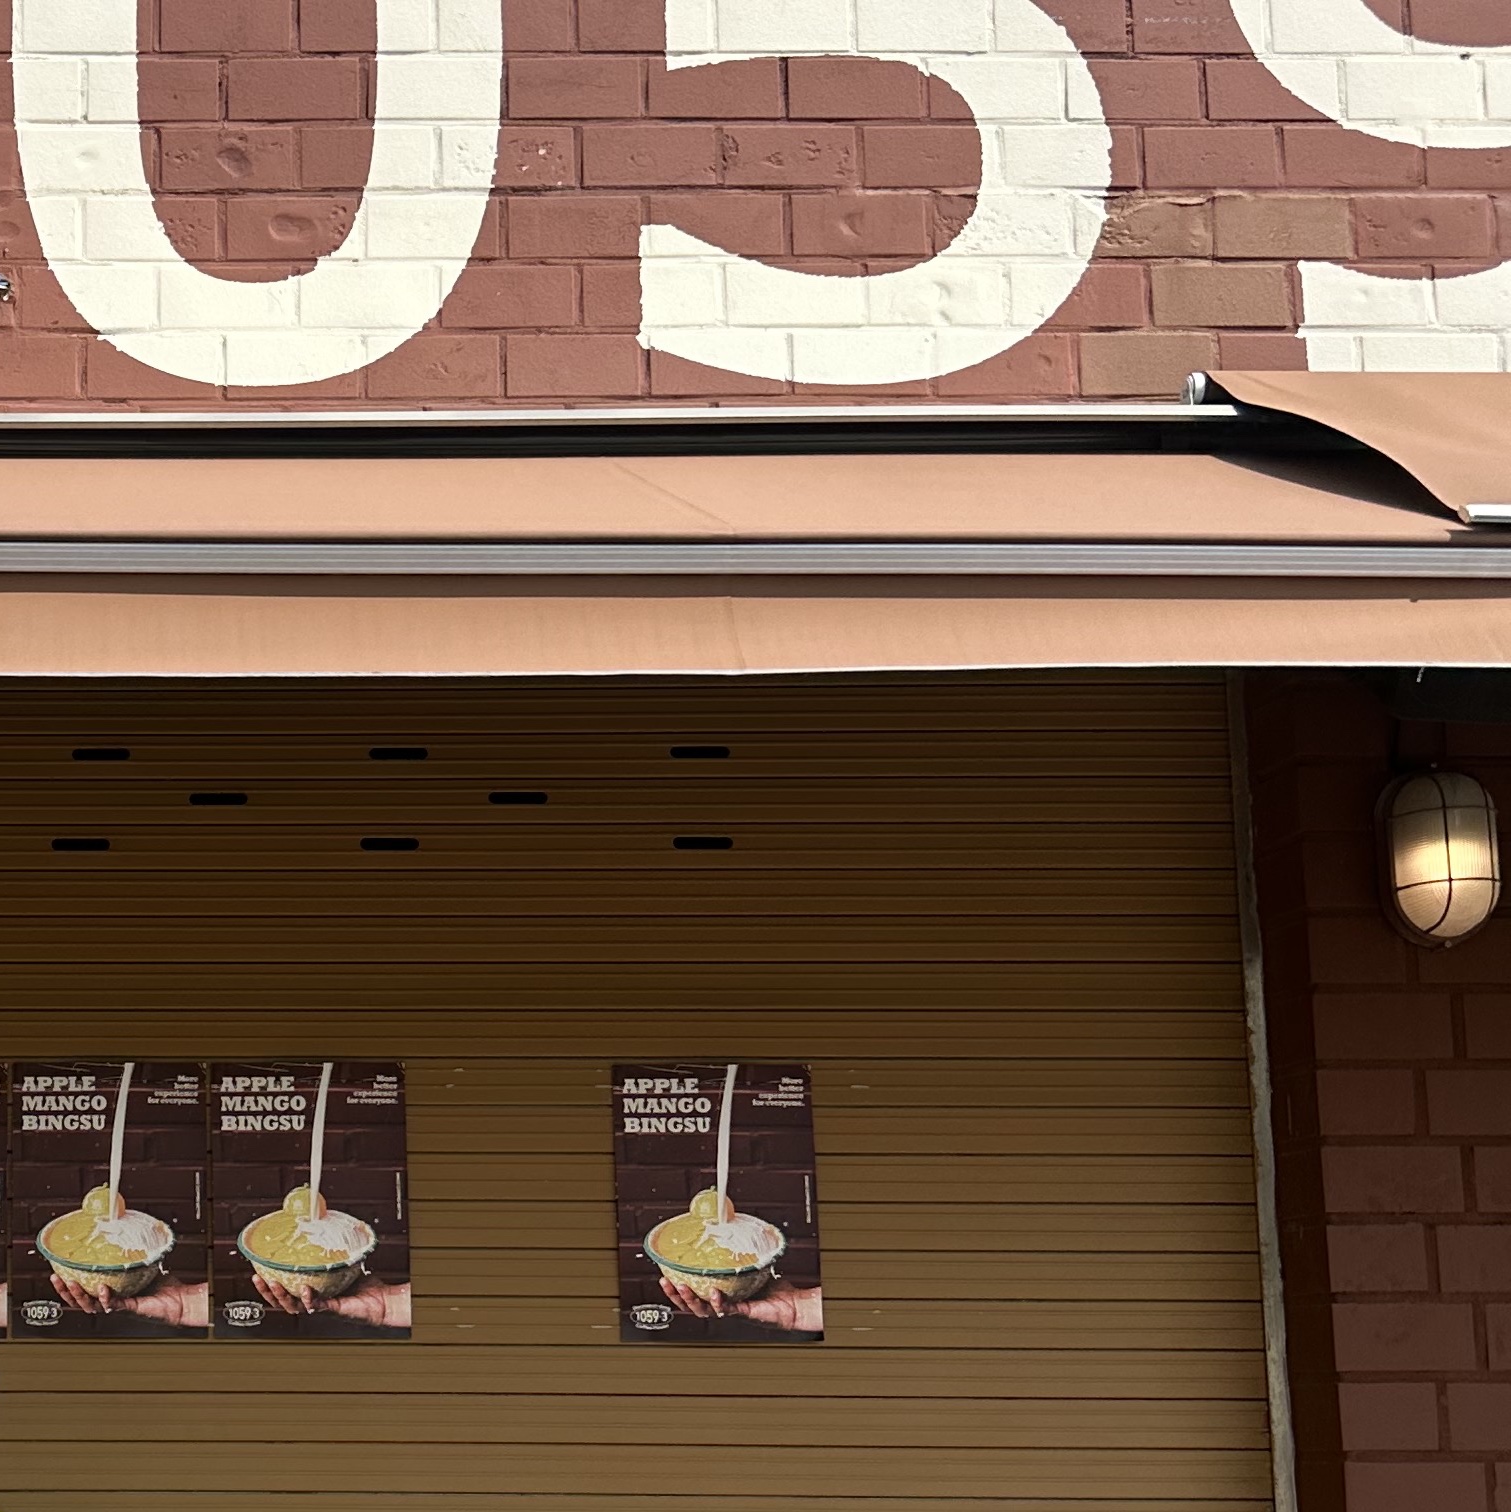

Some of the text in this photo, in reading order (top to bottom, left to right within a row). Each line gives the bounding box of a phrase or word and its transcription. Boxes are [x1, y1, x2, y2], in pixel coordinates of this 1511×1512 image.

[22, 1075, 95, 1092] APPLE
[220, 1076, 294, 1093] APPLE
[623, 1077, 699, 1094] APPLE
[21, 1095, 107, 1112] MANGO
[220, 1095, 306, 1112] MANGO
[623, 1097, 711, 1114] MANGO
[21, 1114, 106, 1131] BINGSU
[220, 1115, 305, 1132] BINGSU
[624, 1116, 711, 1133] BINGSU
